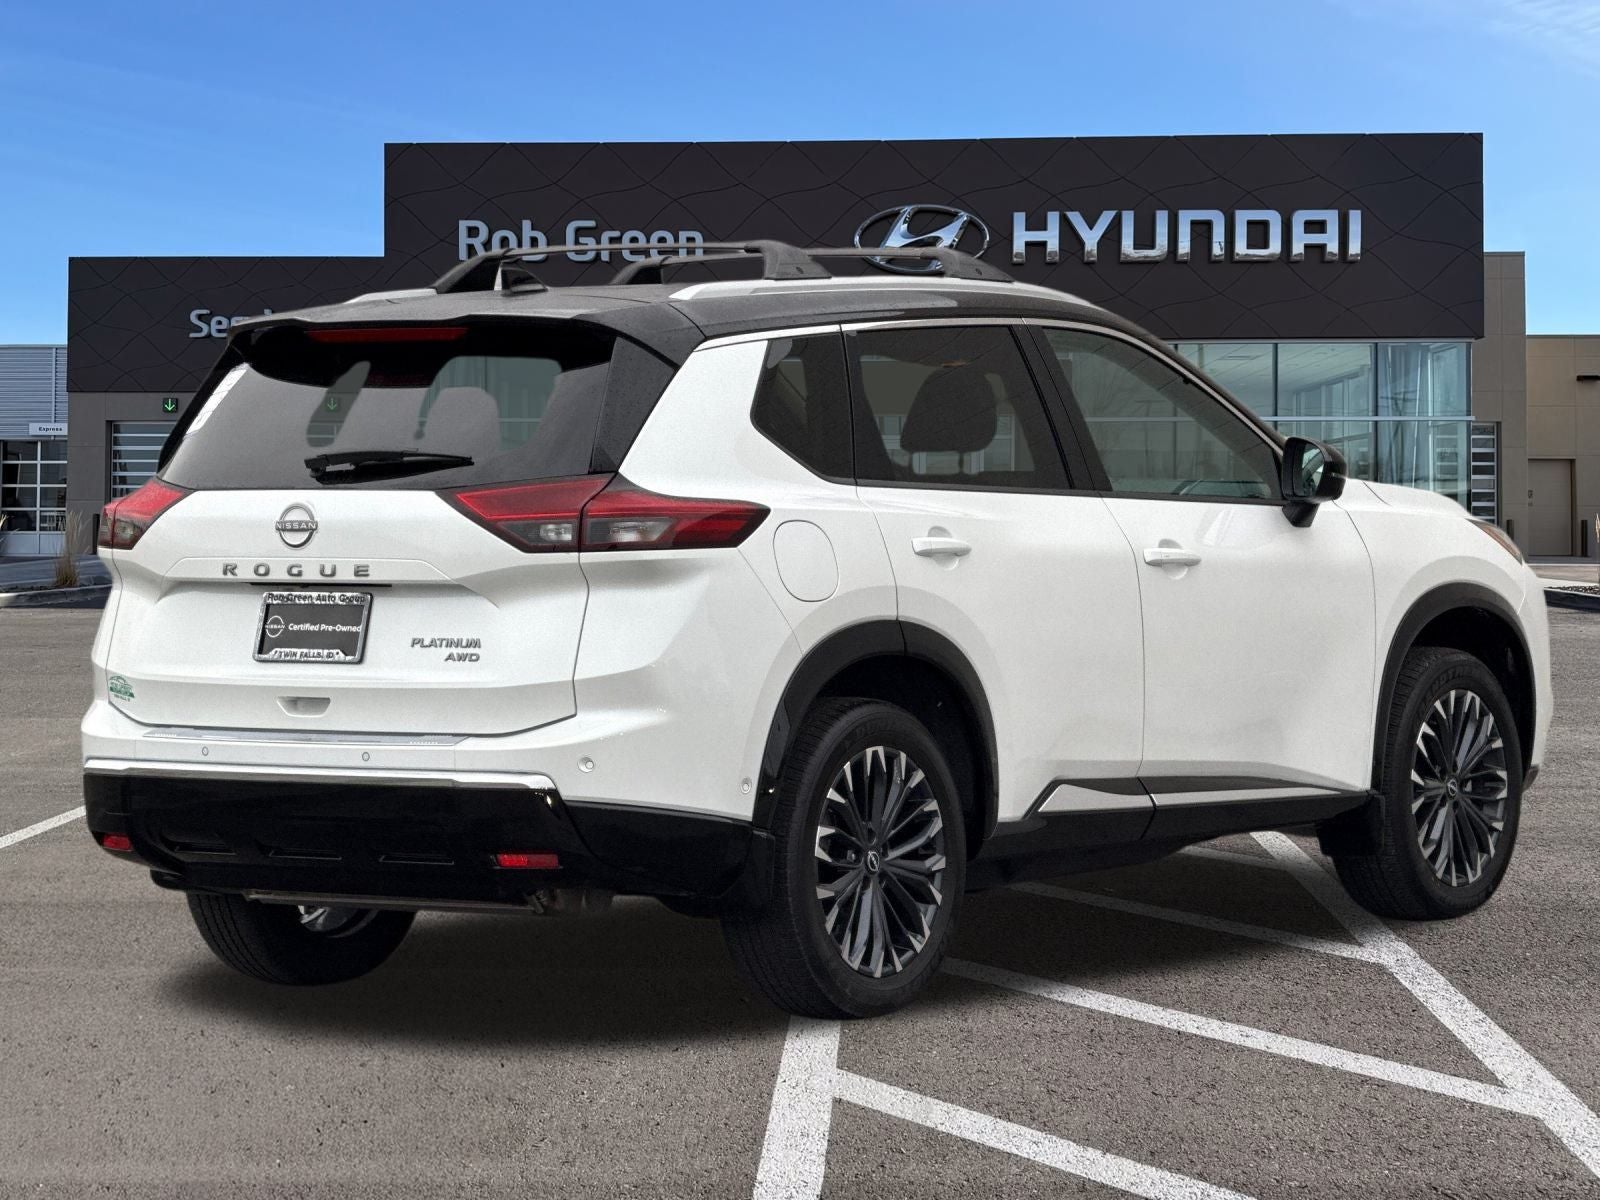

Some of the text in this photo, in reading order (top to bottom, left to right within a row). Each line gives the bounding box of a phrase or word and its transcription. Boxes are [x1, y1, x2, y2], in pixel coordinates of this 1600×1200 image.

[458, 219, 704, 263] Rob Green
[1012, 209, 1362, 264] HYUNDAI
[275, 521, 316, 530] NISSAN
[222, 562, 370, 578] ROGUE
[267, 592, 284, 603] Rob
[286, 593, 313, 604] Green
[315, 593, 336, 603] Auto
[288, 623, 319, 631] Certified
[410, 637, 481, 649] PLATINUM
[279, 650, 298, 659] TWIN
[325, 651, 334, 659] ID
[444, 652, 480, 662] AWD
